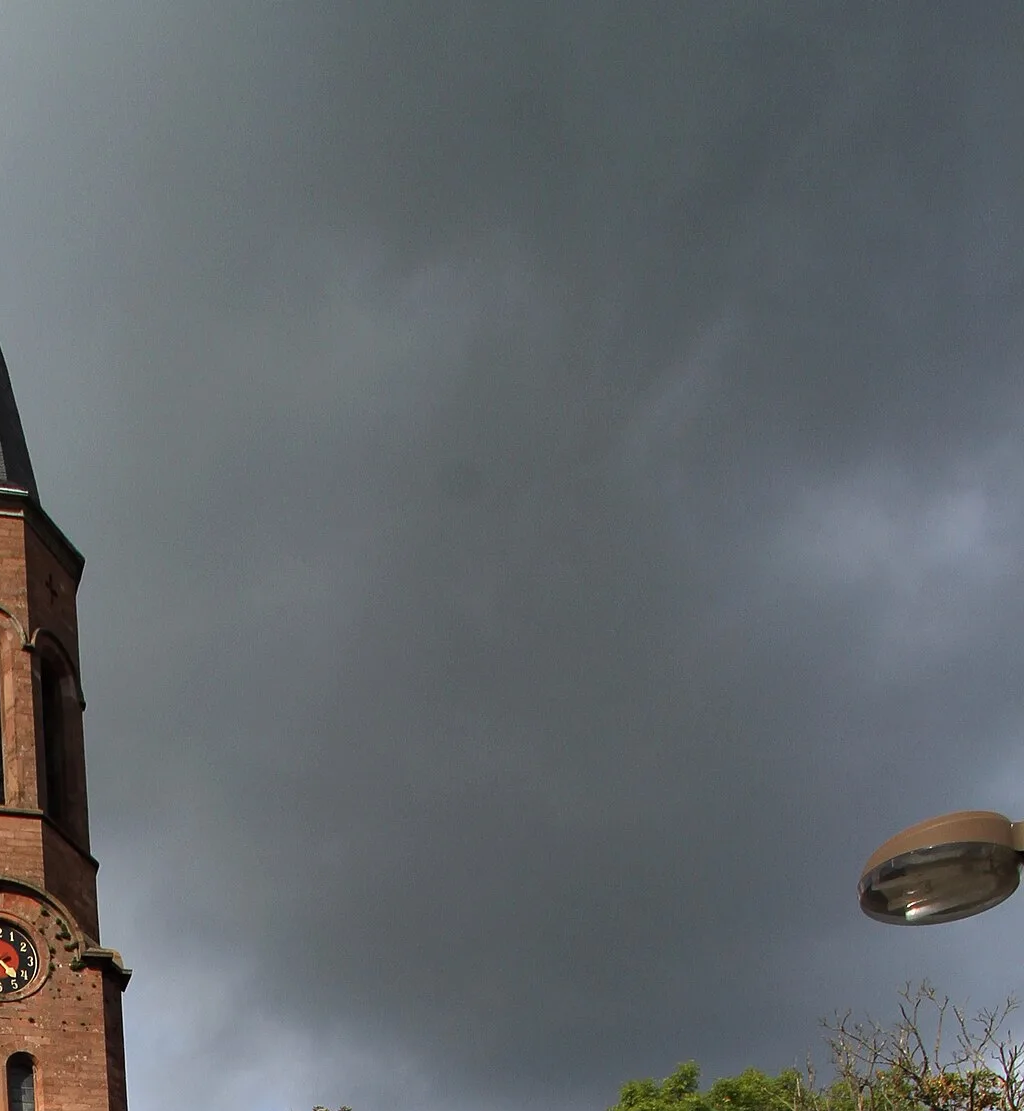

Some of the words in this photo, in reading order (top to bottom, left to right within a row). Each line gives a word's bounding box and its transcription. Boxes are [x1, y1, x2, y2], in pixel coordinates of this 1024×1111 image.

[9, 931, 14, 942] 1
[20, 942, 27, 952] 2
[27, 956, 34, 967] 3
[20, 970, 28, 980] 4
[11, 979, 18, 989] 5
